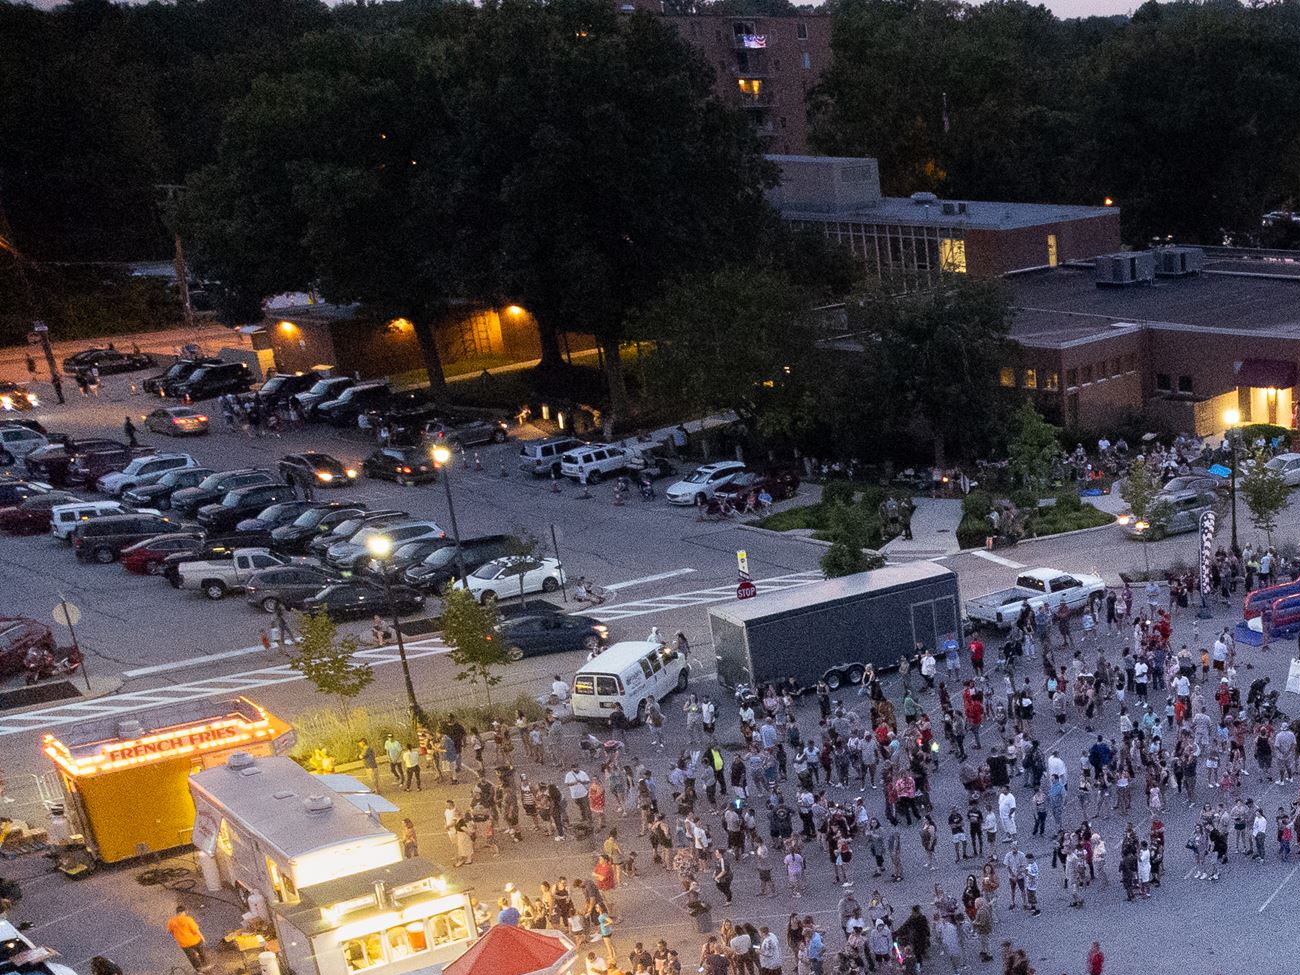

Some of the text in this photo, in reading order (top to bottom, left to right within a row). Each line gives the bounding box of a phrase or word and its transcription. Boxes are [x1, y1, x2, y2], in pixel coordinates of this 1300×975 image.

[737, 587, 755, 598] STOP
[110, 738, 183, 762] FRENCH
[189, 726, 237, 746] FRIES
